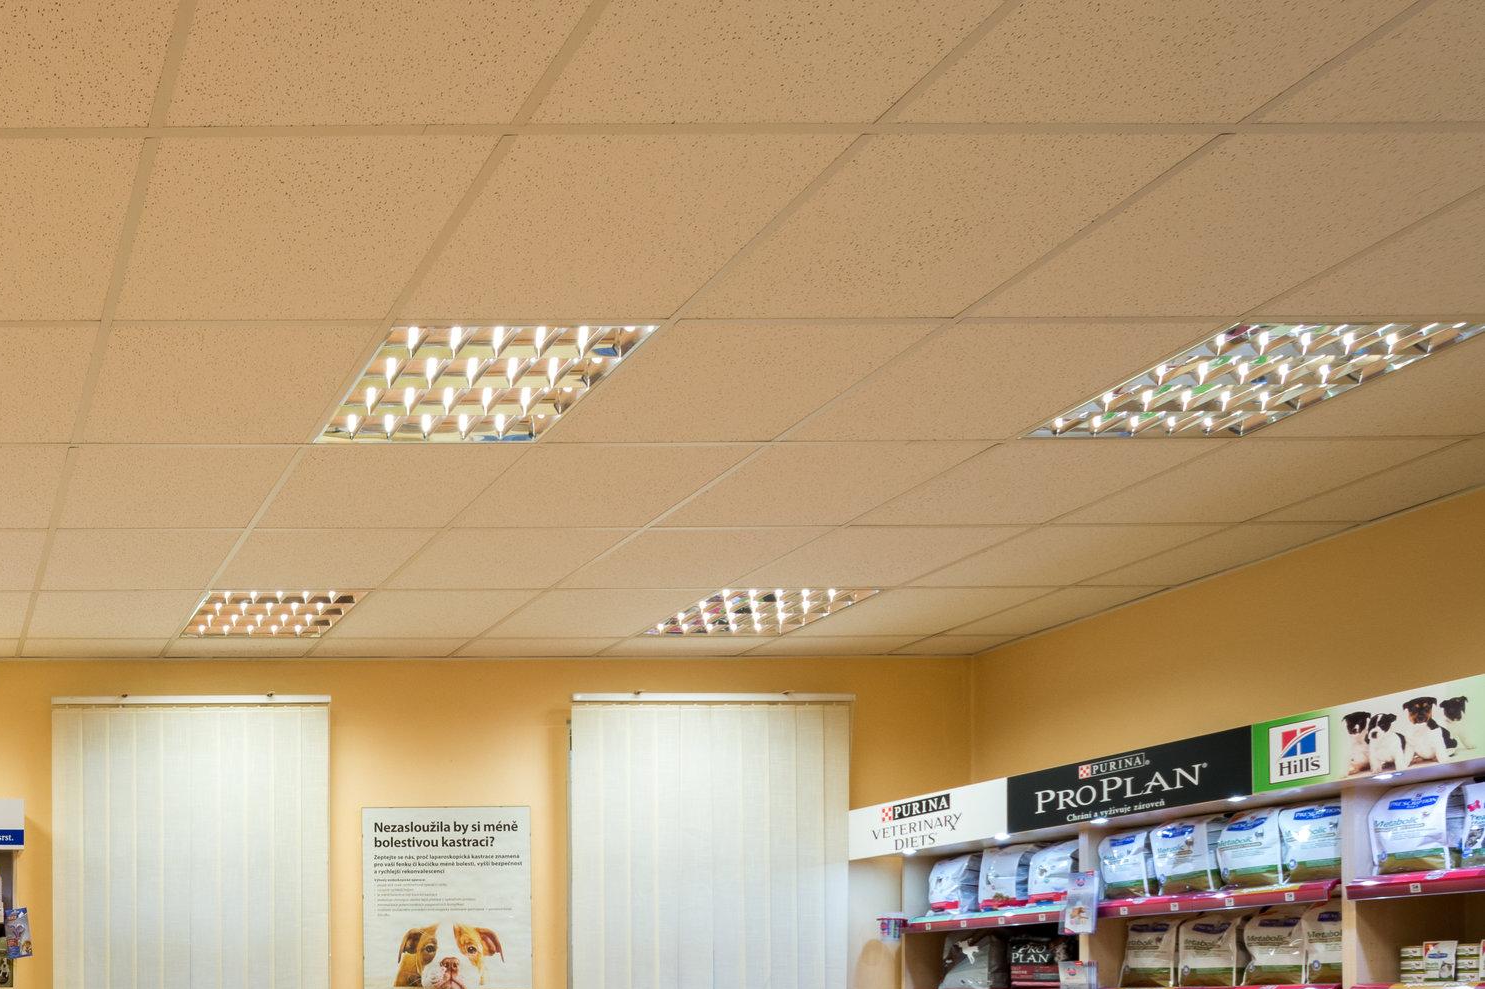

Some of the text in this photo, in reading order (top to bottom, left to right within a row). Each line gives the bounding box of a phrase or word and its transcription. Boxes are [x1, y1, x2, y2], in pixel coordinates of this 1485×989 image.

[1092, 756, 1143, 775] PURINA
[1278, 755, 1321, 778] Hill's
[894, 795, 950, 820] PURINA
[1066, 811, 1093, 823] Chrání
[1133, 798, 1166, 812] zároveň
[373, 820, 519, 835] Nezasloužila by si méně
[872, 812, 963, 841] VETERINARY
[373, 835, 495, 848] bolestivou kastraci?
[894, 833, 936, 851] DIETS
[1011, 952, 1050, 964] PLAN
